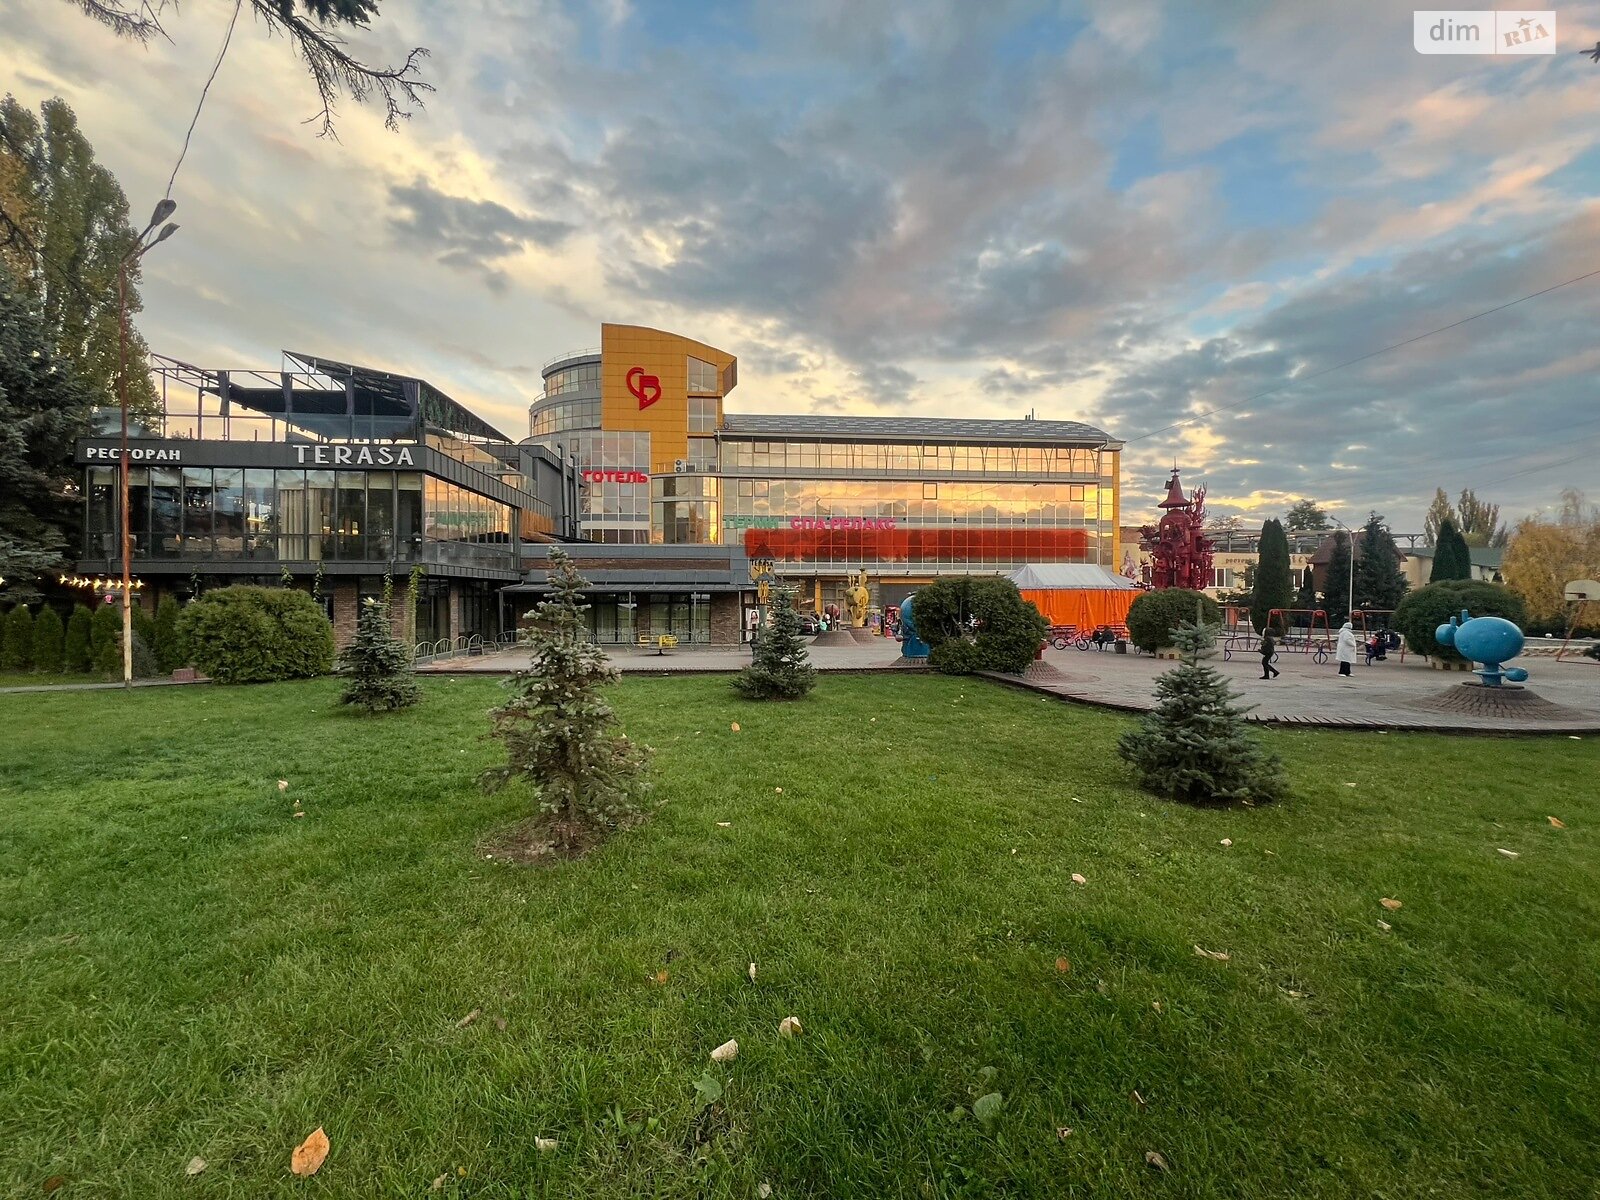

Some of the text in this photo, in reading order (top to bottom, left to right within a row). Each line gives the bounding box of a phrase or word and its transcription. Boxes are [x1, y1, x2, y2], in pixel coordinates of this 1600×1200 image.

[292, 444, 414, 466] TERASA
[583, 470, 649, 484] ГОТЕЛЬ
[723, 516, 897, 530] ТЕРМИ СПА-РЕЛАКС
